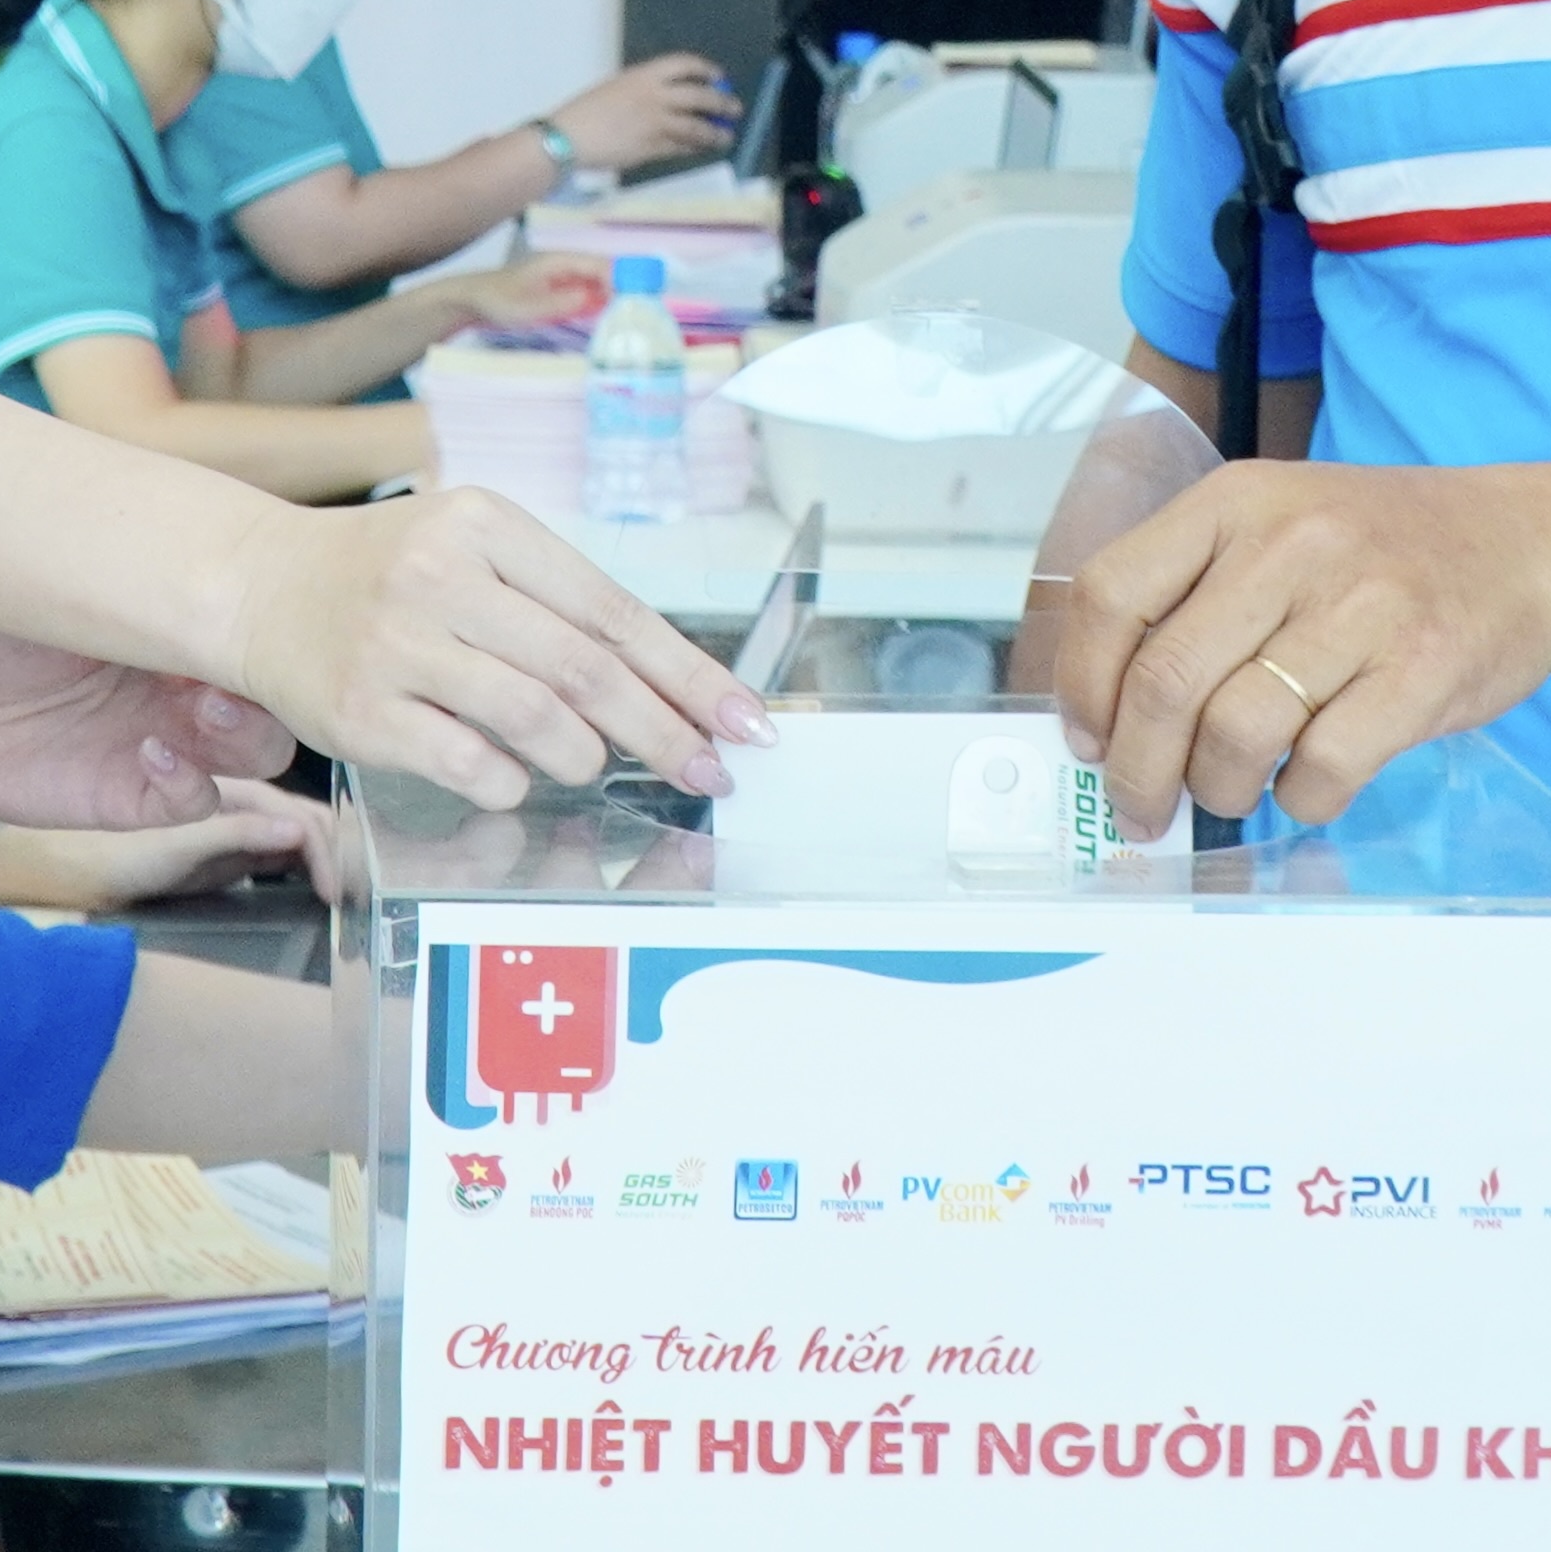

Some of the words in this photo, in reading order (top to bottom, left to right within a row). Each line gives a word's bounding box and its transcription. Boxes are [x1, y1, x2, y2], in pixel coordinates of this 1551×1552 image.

[624, 1174, 672, 1188] GAS
[902, 1177, 994, 1202] PVcom
[1138, 1164, 1271, 1194] PTSC
[1351, 1176, 1429, 1203] PVI
[618, 1192, 698, 1207] SOUTH
[1350, 1205, 1437, 1219] INSURANCE
[940, 1203, 1002, 1222] Bank
[445, 1323, 636, 1383] Chương
[641, 1325, 781, 1373] trình
[800, 1325, 909, 1375] hiến
[927, 1335, 1041, 1375] máu
[444, 1400, 672, 1487] NHIỆT
[697, 1394, 950, 1476] HUYẾT
[977, 1406, 1246, 1478] NGƯỜI
[1273, 1399, 1439, 1480] DẦU
